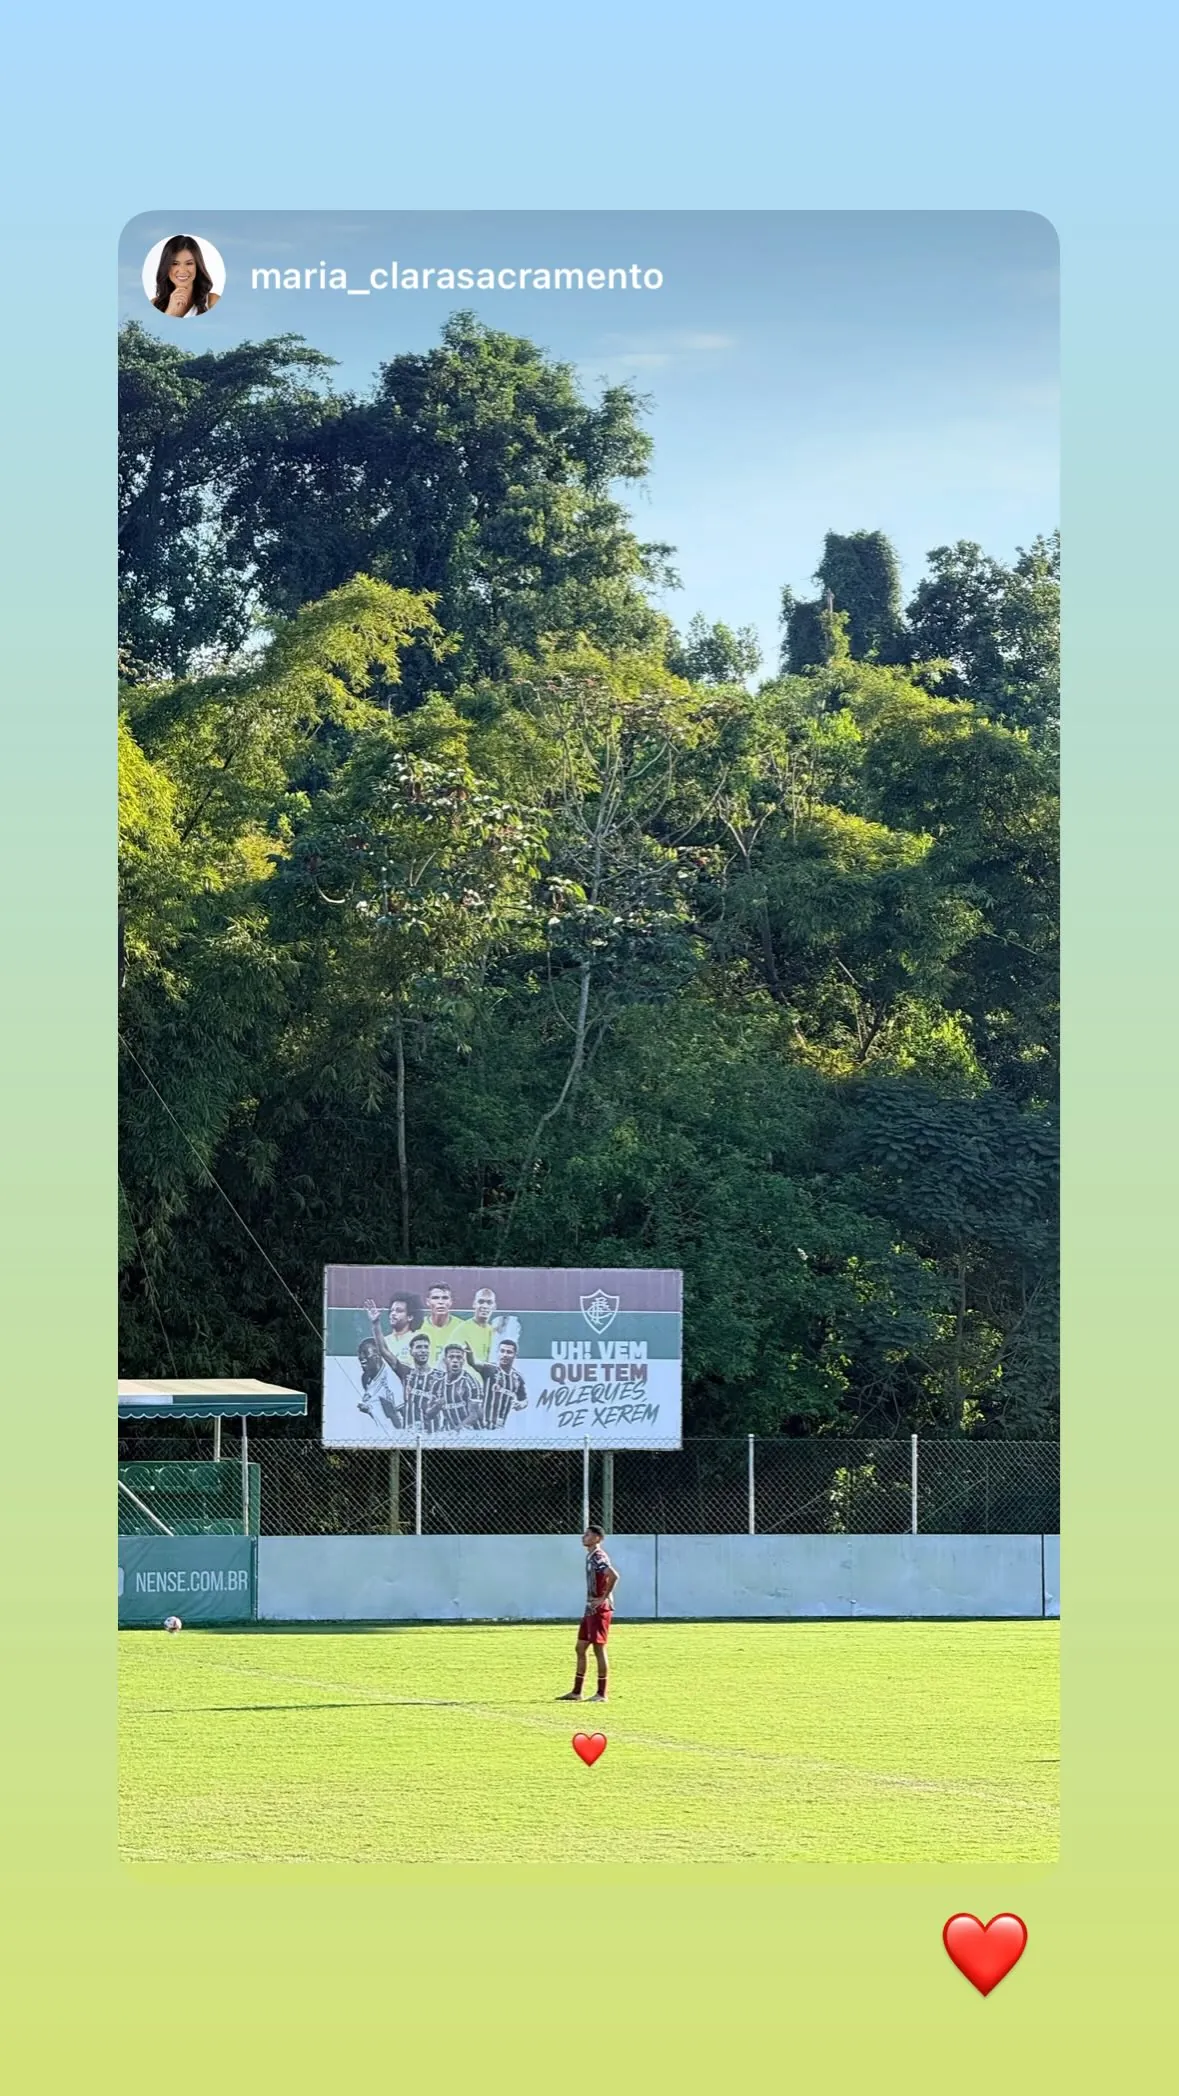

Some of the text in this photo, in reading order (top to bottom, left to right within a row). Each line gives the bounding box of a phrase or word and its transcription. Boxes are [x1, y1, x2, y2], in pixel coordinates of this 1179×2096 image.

[551, 1341, 648, 1360] UH! VEM
[550, 1362, 648, 1385] QUE TEM
[536, 1381, 647, 1412] MOLEQUES
[557, 1409, 589, 1428] DE
[135, 1570, 249, 1593] NENSE.COM.BR
